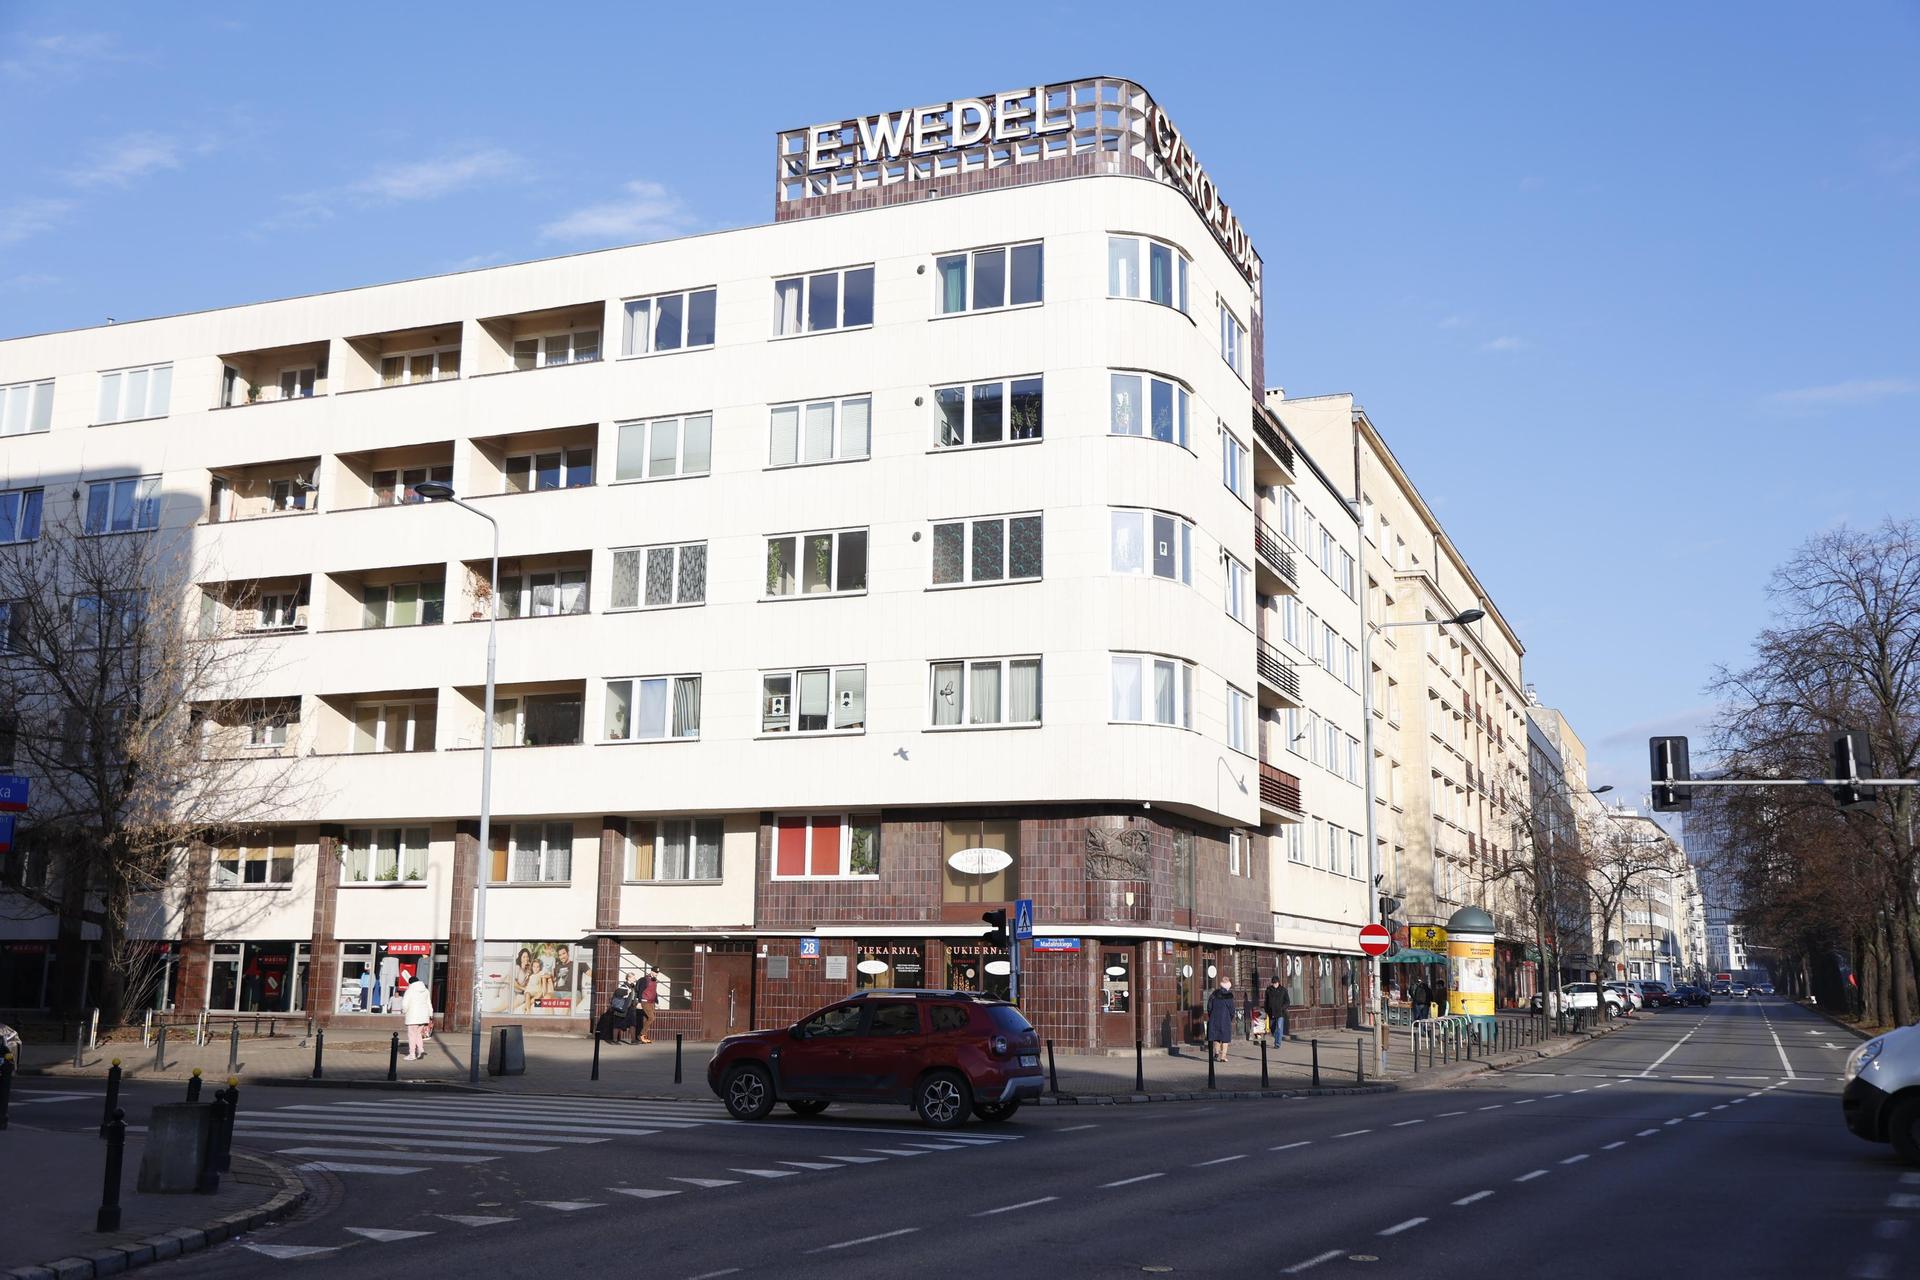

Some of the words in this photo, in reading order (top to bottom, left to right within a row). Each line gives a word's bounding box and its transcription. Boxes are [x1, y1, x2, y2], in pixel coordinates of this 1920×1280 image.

[390, 943, 427, 951] wadima
[803, 942, 816, 954] 28
[857, 946, 919, 955] PIEKARNIA
[945, 946, 1009, 955] CUKIERNI
